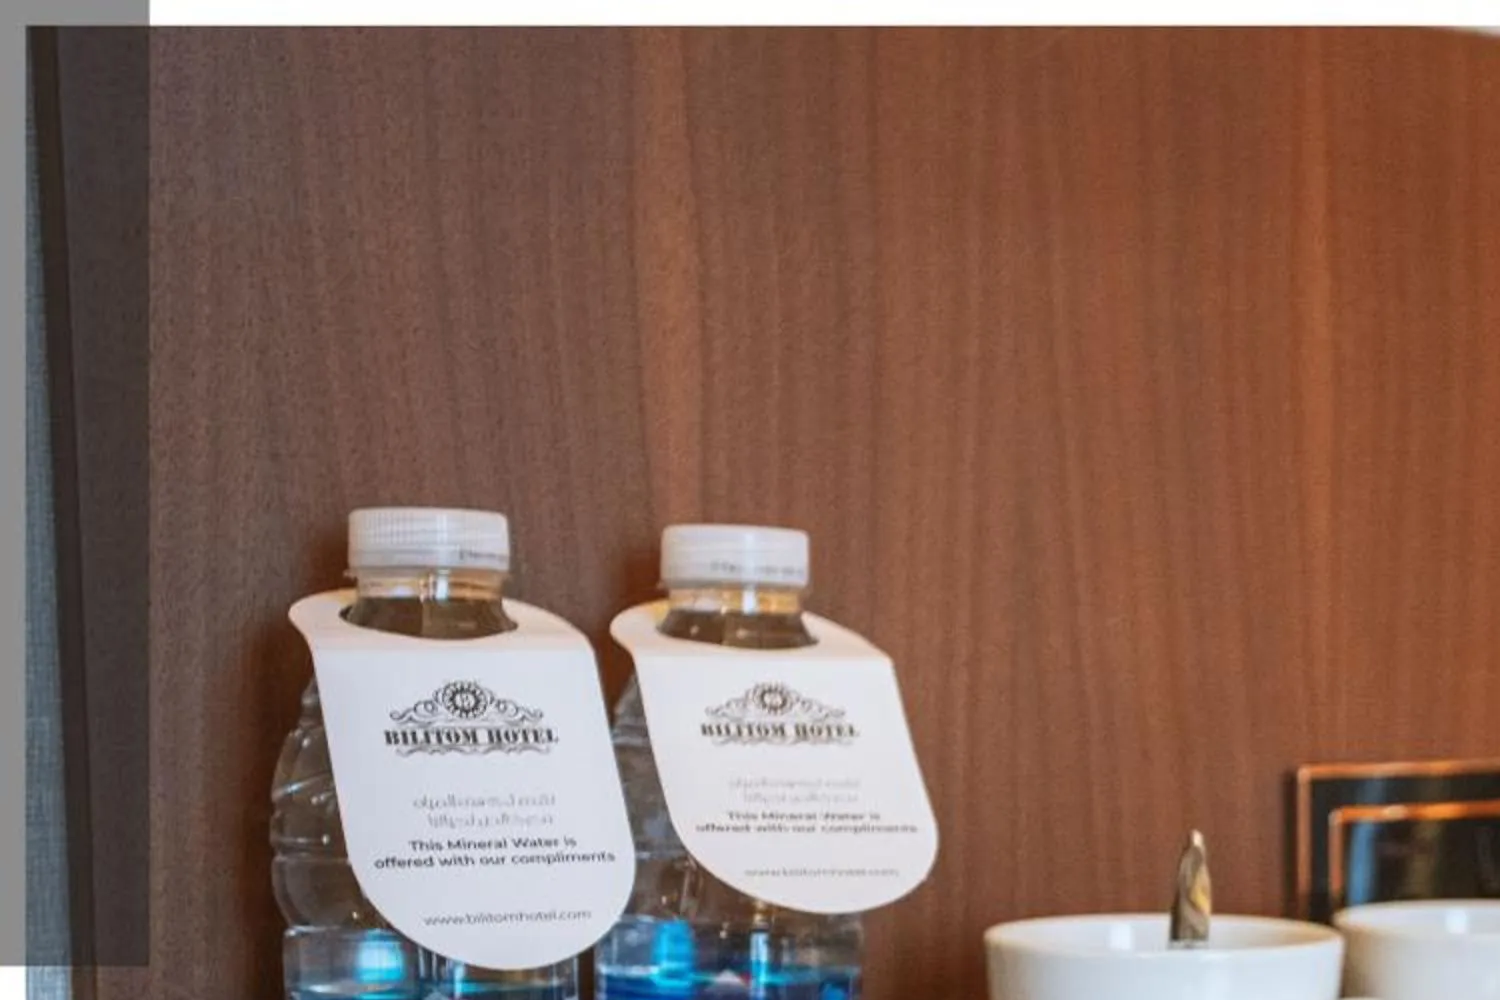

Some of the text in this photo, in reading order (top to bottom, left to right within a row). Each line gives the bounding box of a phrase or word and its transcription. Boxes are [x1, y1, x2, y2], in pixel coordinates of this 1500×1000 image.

[384, 728, 559, 746] BILITOM HOTEL
[408, 835, 578, 852] This Mineral Water is
[373, 851, 616, 870] offered with our compliments
